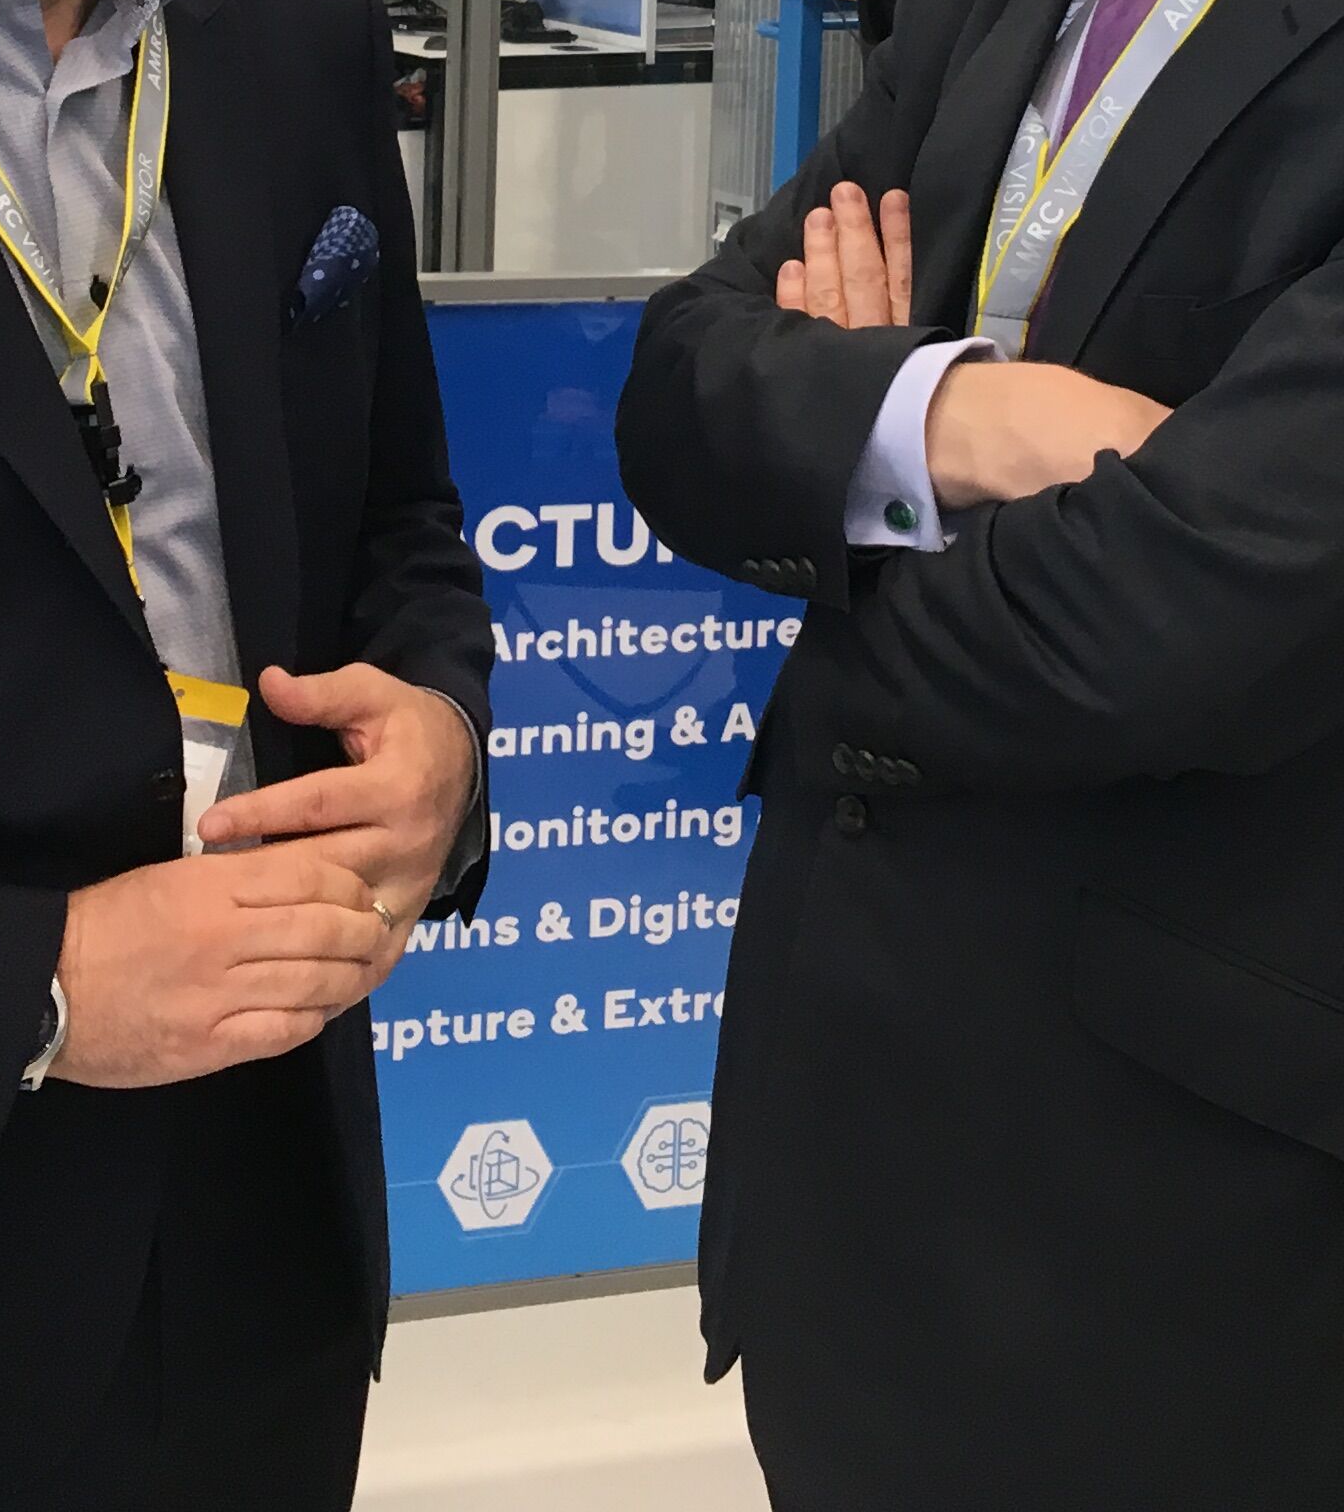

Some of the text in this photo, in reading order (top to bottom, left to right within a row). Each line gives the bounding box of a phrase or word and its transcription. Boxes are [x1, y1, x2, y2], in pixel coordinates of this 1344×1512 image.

[146, 14, 164, 91] AMRC
[1009, 200, 1064, 282] AMRC
[460, 502, 673, 572] CTU
[491, 615, 804, 662] Architecture
[488, 711, 654, 760] arning
[670, 705, 707, 746] &
[535, 901, 574, 943] &
[550, 993, 589, 1035] &
